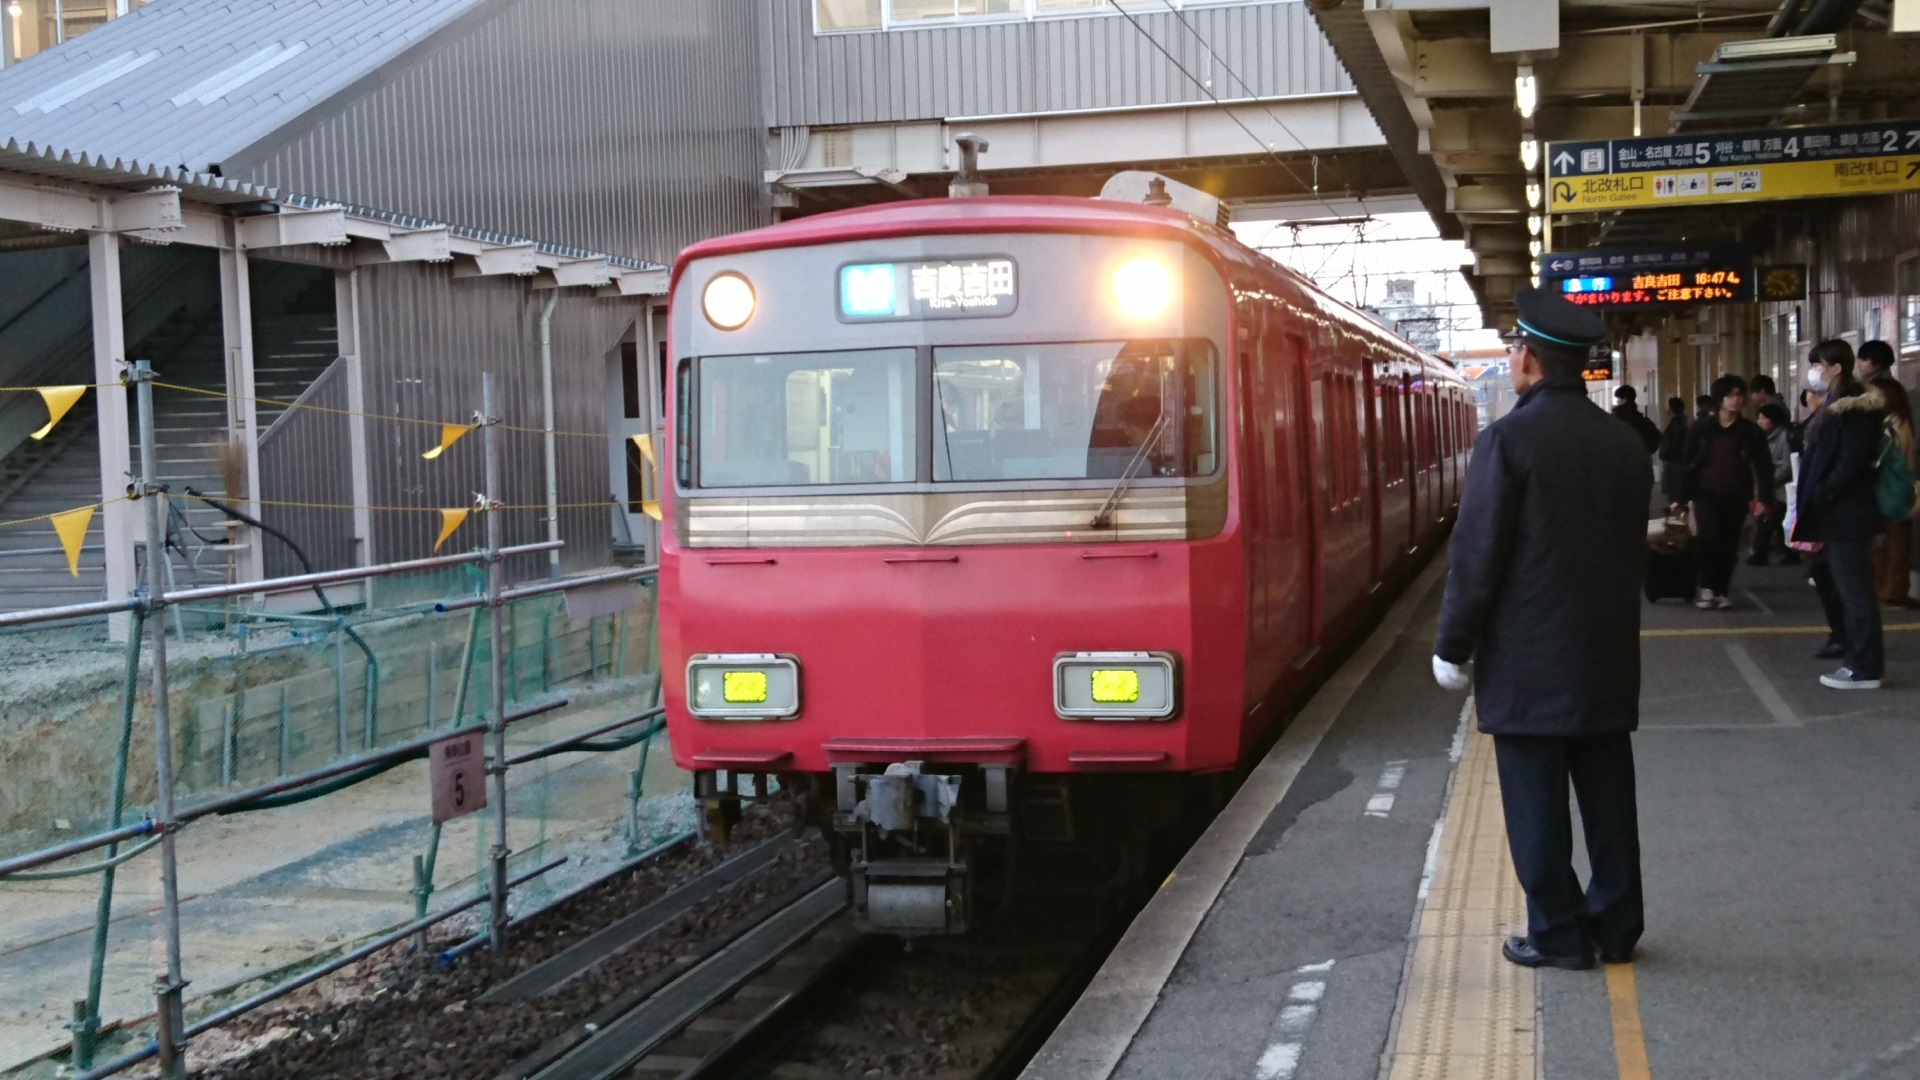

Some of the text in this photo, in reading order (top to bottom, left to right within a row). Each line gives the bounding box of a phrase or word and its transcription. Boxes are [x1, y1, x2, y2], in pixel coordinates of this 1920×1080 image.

[1675, 143, 1693, 157] 方面
[1695, 142, 1711, 164] 5
[1783, 136, 1800, 158] 4
[1882, 130, 1899, 152] 2
[1738, 170, 1759, 178] TAXI
[1834, 160, 1899, 177] 南改札口
[1583, 176, 1644, 194] 北改札口
[1582, 193, 1637, 203] North Gates
[911, 261, 1013, 300] 吉良吉田
[1632, 274, 1681, 289] 吉良吉田
[1695, 272, 1725, 285] 16:47
[929, 295, 998, 308] Kira-Yoshida
[455, 772, 465, 807] 5
